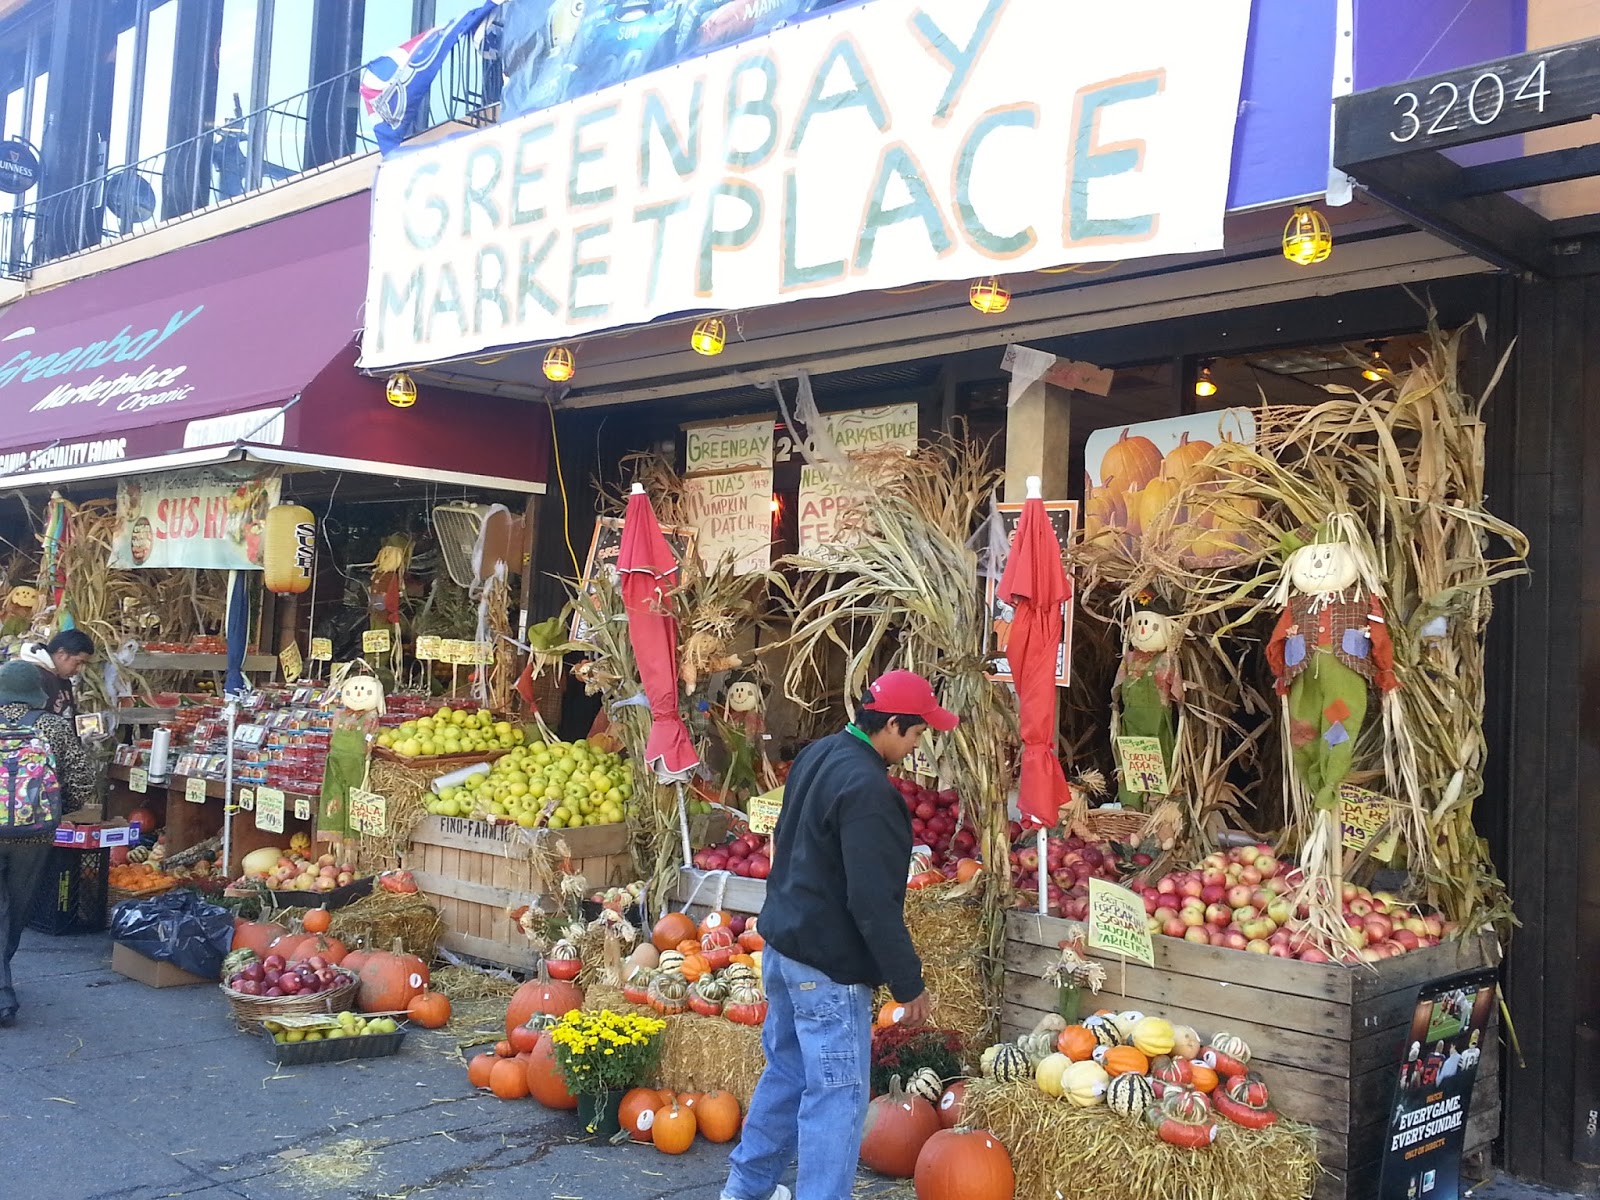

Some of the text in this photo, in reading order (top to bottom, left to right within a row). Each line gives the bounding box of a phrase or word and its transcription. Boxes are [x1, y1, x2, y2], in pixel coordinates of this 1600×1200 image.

[1389, 60, 1552, 143] 3204
[402, 0, 1009, 253] GREENBAY
[0, 160, 33, 178] UINNESS
[373, 66, 1167, 356] MARKETPLACE
[29, 363, 188, 413] Marketplace
[116, 384, 195, 412] Organic
[88, 437, 127, 463] FOODS
[688, 435, 770, 463] GREENBAY
[707, 476, 746, 496] INA'S
[156, 496, 229, 539] SUSHI
[689, 490, 748, 521] PUMPKIN
[710, 514, 754, 539] PATCH
[800, 523, 830, 547] FE
[1399, 1104, 1434, 1131] EVERY
[1390, 1124, 1426, 1152] EVERY
